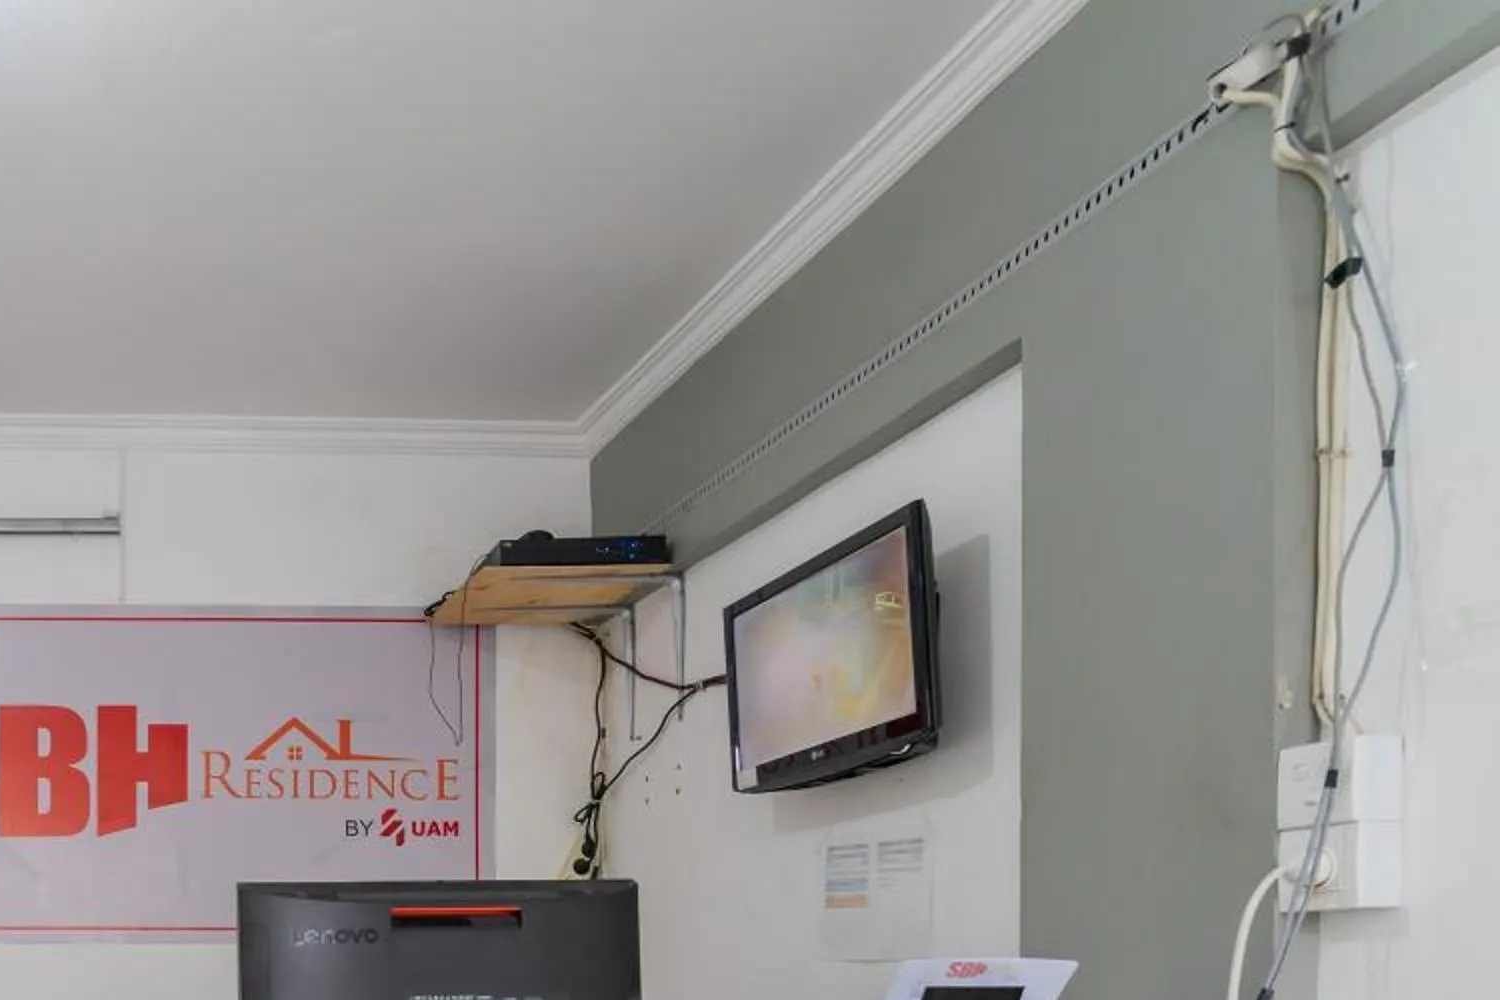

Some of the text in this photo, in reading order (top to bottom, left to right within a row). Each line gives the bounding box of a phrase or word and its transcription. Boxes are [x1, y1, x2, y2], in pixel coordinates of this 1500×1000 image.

[201, 750, 461, 801] RESIDENCE
[345, 819, 461, 838] BY UAM
